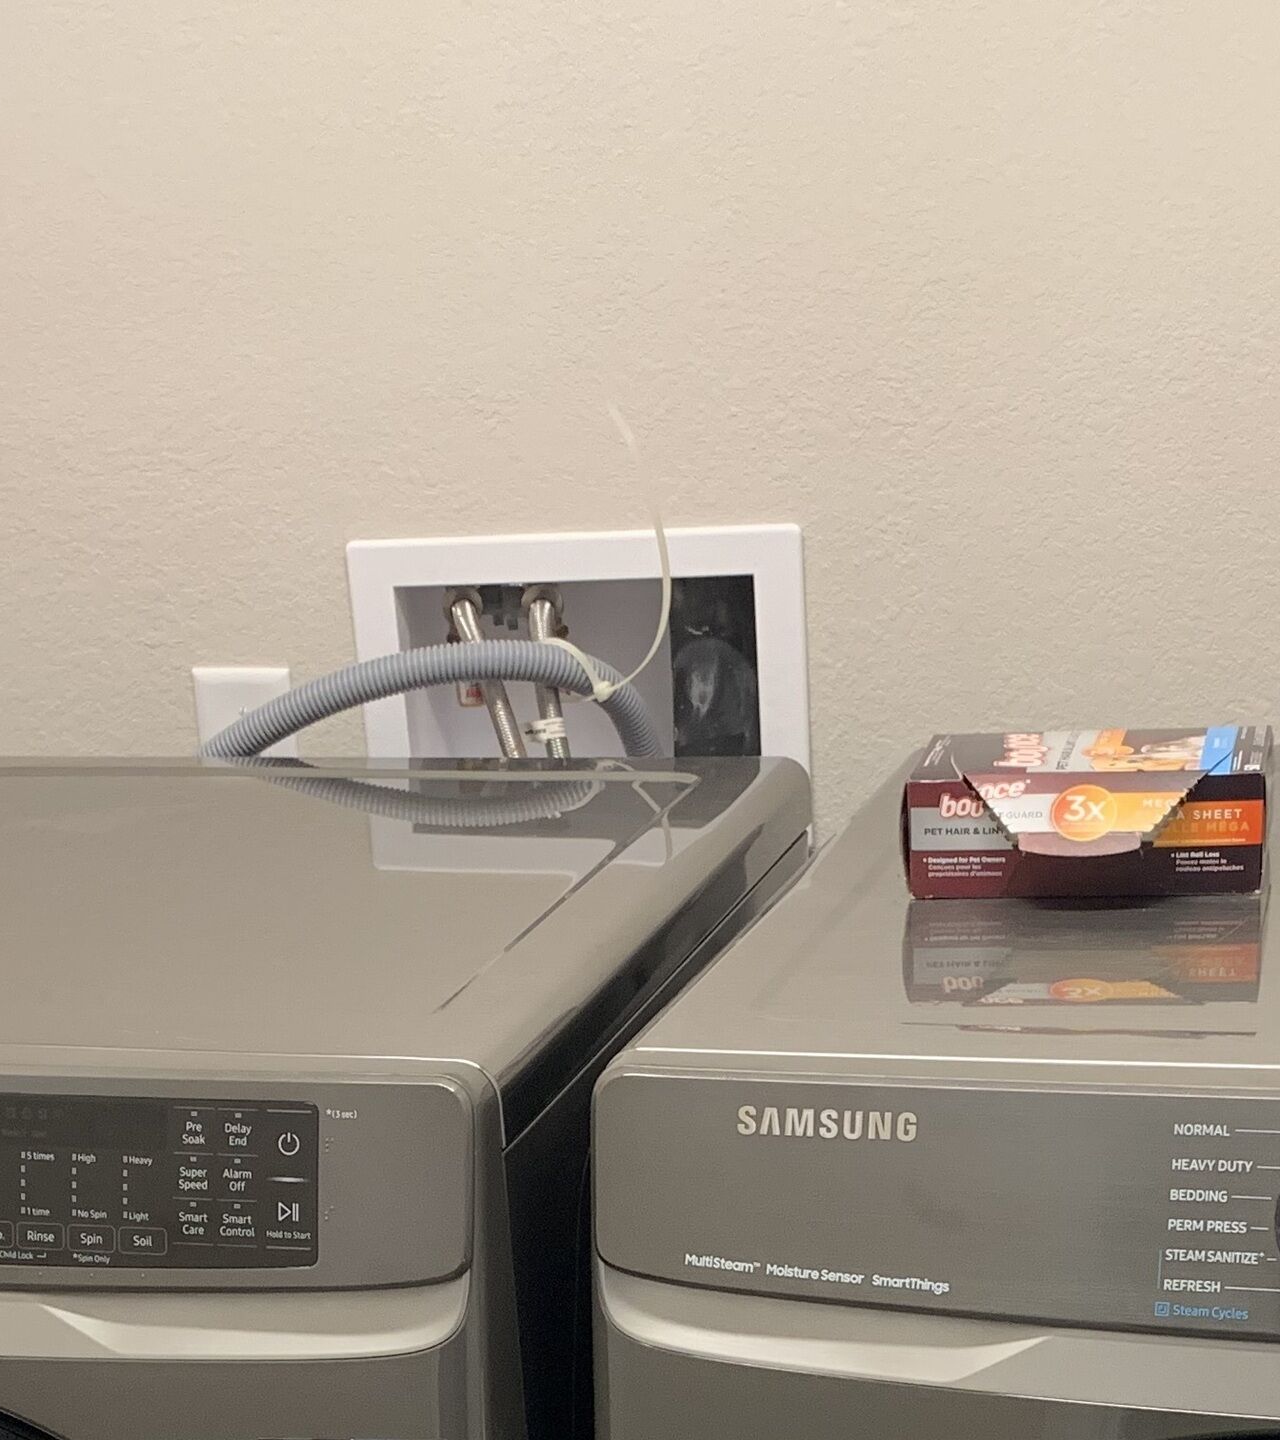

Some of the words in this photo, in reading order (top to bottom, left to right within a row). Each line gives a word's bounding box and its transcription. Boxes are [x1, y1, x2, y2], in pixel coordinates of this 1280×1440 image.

[1064, 794, 1105, 822] 3x
[1192, 808, 1243, 820] SHEET
[924, 828, 943, 836] PET
[186, 1122, 202, 1132] Pre
[225, 1123, 252, 1135] Delay
[736, 1105, 918, 1142] SAMSUNG
[1174, 1124, 1230, 1136] NORMAL
[182, 1134, 205, 1145] Soak
[229, 1136, 247, 1147] End
[33, 1152, 55, 1161] times
[77, 1153, 96, 1164] High
[129, 1156, 153, 1166] Heavy
[1172, 1158, 1216, 1171] HEAVY
[1218, 1160, 1253, 1172] DUTY
[179, 1167, 207, 1179] Super
[223, 1169, 252, 1179] Alarm
[178, 1179, 208, 1191] Speed
[229, 1181, 246, 1191] Off
[1170, 1189, 1228, 1203] BEDDING
[32, 1208, 50, 1216] time
[77, 1209, 89, 1218] No
[90, 1210, 107, 1220] Spin
[129, 1211, 149, 1222] Light
[178, 1212, 208, 1223] Smart
[222, 1214, 252, 1225] Smart
[182, 1224, 205, 1235] Care
[1168, 1218, 1204, 1231] PERM
[1206, 1220, 1248, 1233] PRESS
[27, 1230, 55, 1242] Rinse
[220, 1226, 255, 1237] Control
[266, 1230, 283, 1239] Hold
[293, 1231, 311, 1240] Start
[80, 1232, 103, 1246] Spin
[133, 1235, 152, 1247] Soil
[18, 1252, 33, 1260] Lock
[94, 1254, 110, 1264] Only
[1165, 1249, 1206, 1262] STEAM
[766, 1263, 819, 1281] Moisture
[820, 1269, 865, 1285] Sensor
[871, 1274, 950, 1295] SmartThings
[1163, 1278, 1221, 1293] REFRESH
[1172, 1304, 1210, 1318] Steam
[1211, 1306, 1249, 1320] Cycles
